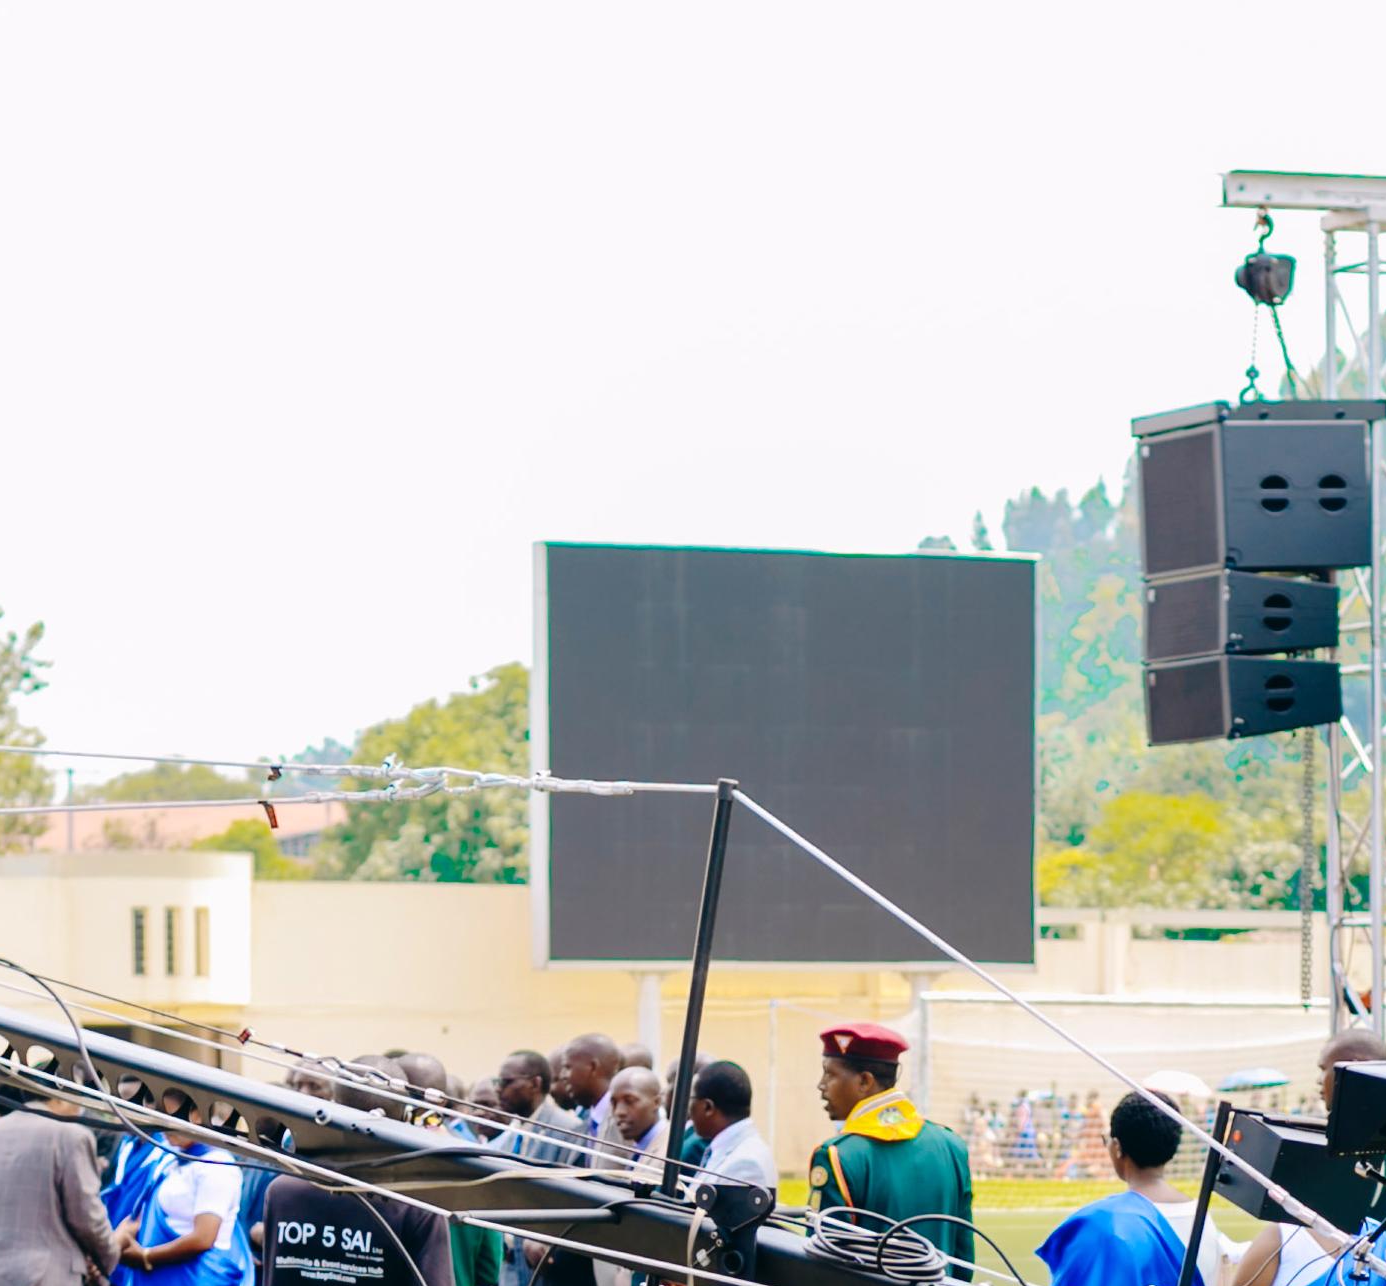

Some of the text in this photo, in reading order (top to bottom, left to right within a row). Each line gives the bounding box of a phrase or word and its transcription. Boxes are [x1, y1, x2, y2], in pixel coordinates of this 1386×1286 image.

[278, 1222, 316, 1245] TOP
[322, 1225, 336, 1247] 5
[341, 1227, 372, 1253] SAI
